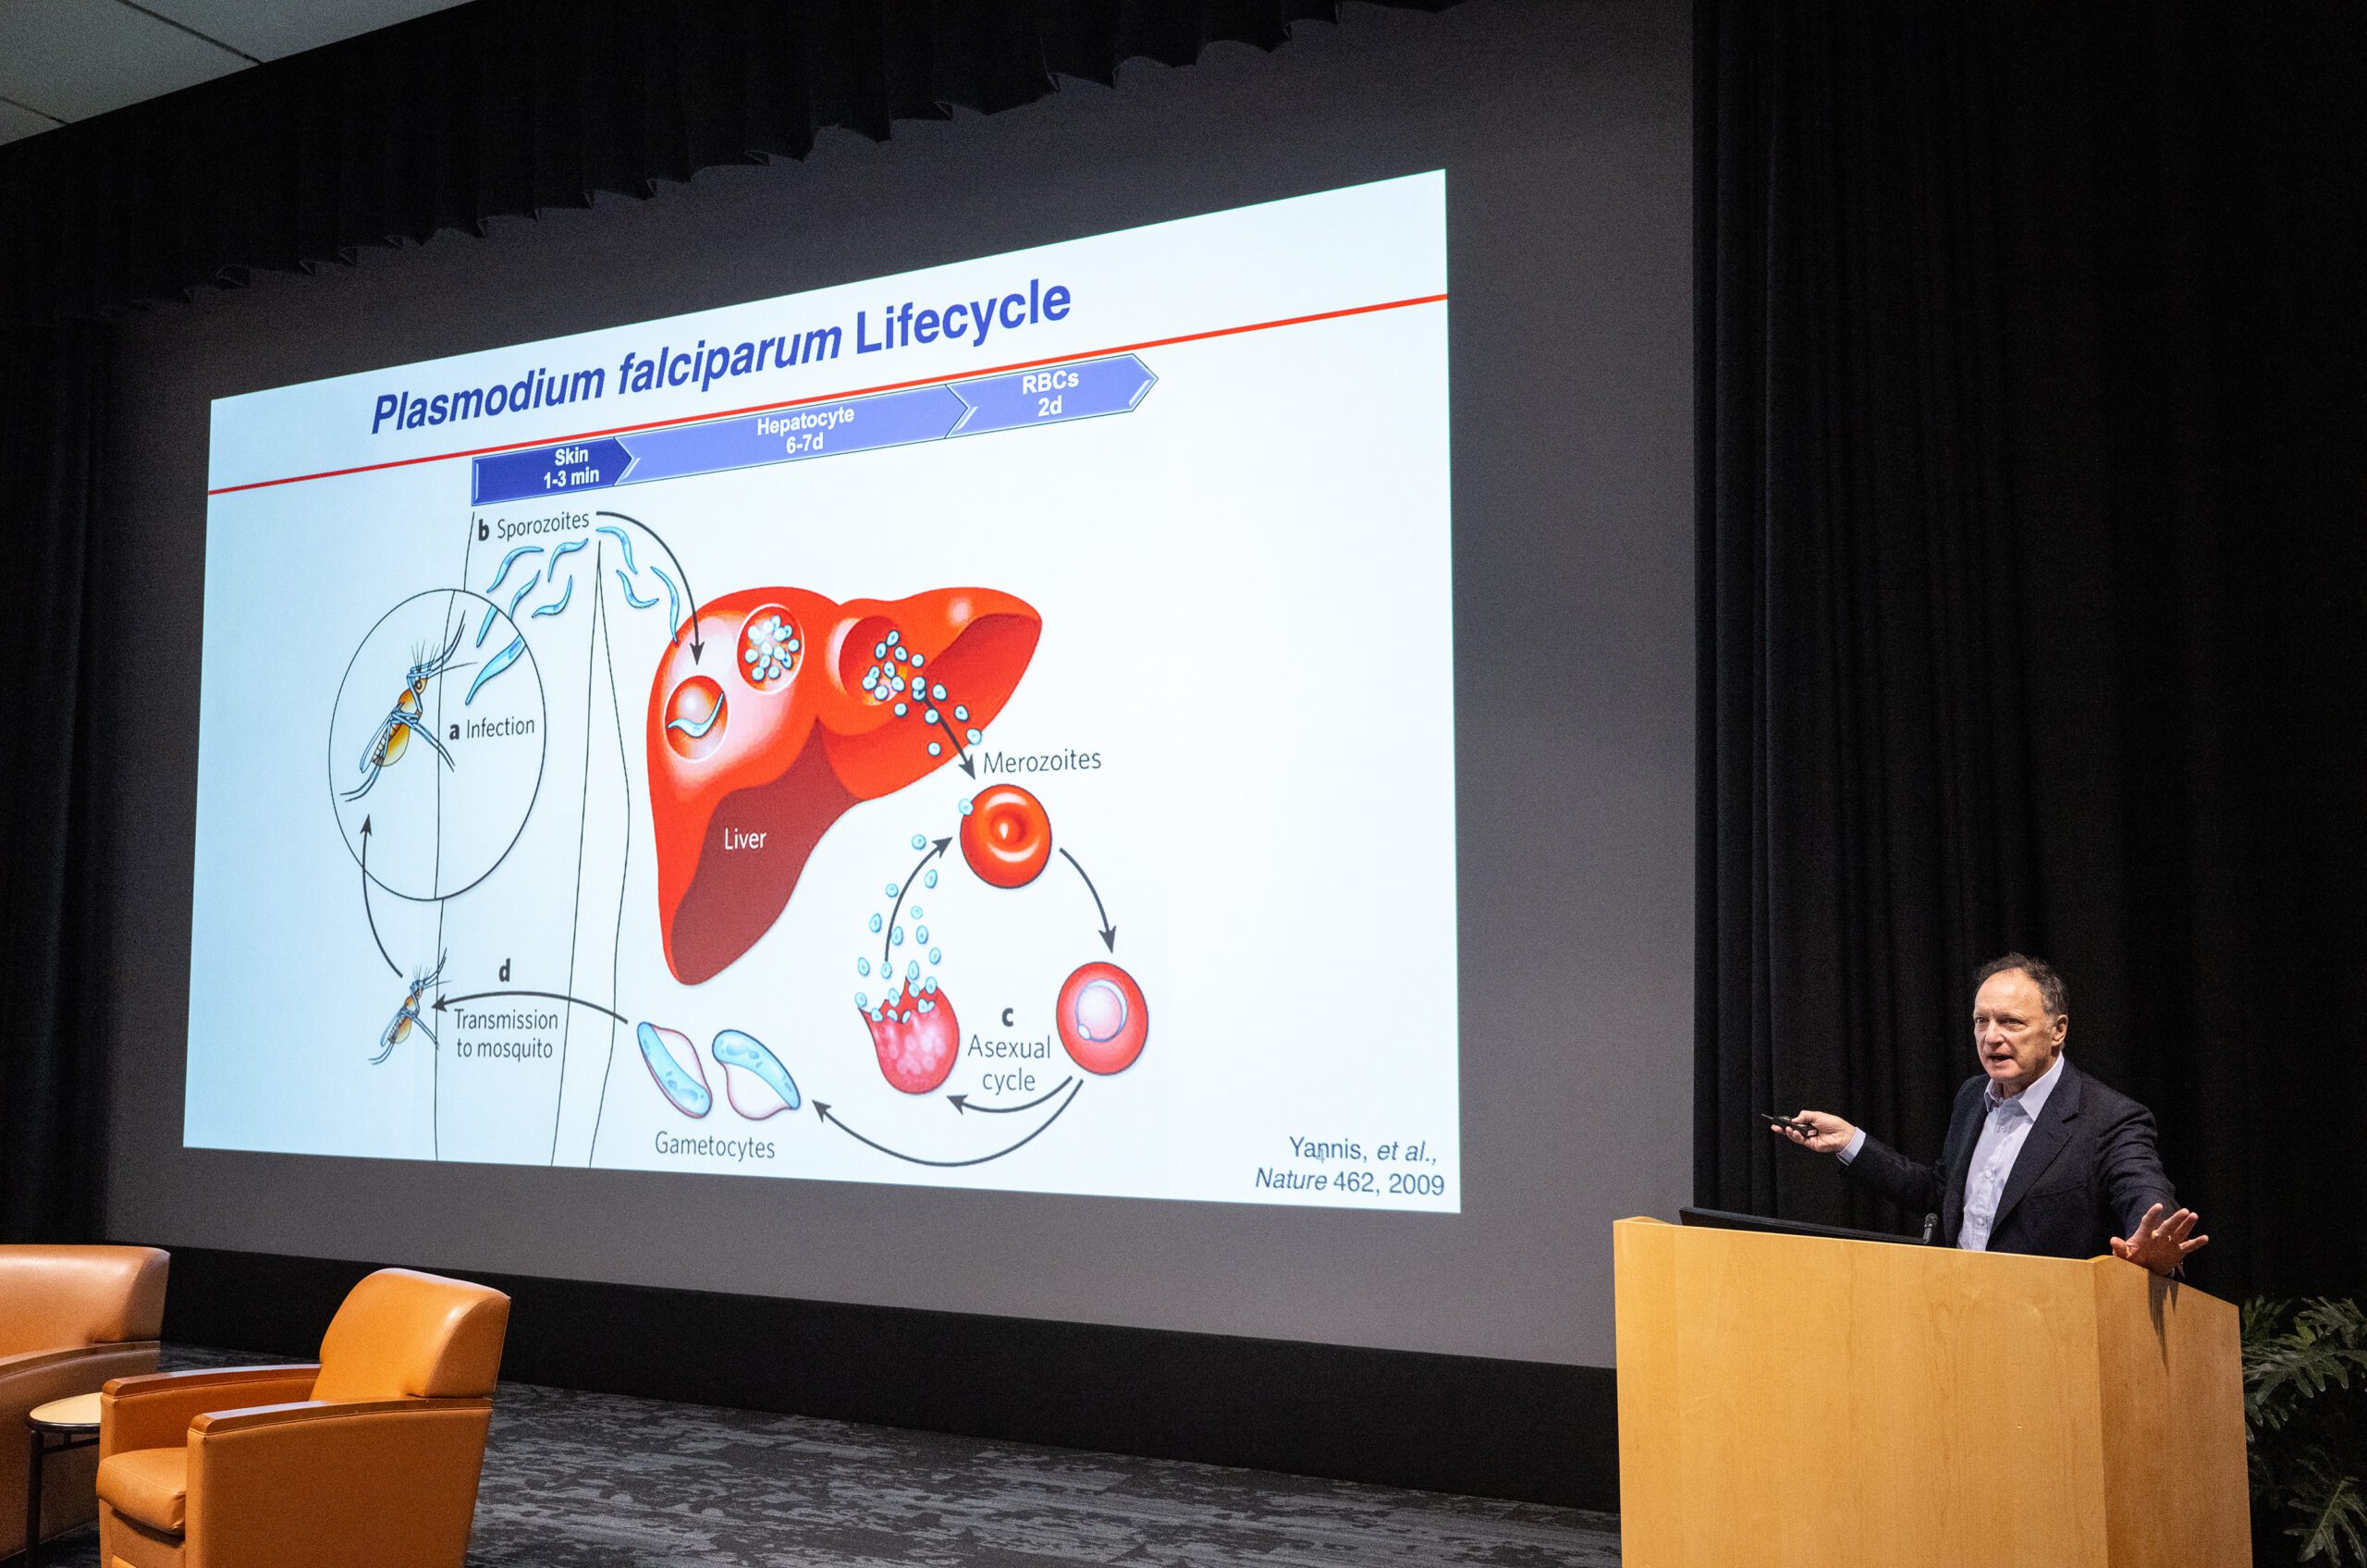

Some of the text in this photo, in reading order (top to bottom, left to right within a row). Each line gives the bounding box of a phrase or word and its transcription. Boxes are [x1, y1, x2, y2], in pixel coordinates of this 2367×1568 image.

[371, 278, 1072, 435] Plasmodium falciparum Lifecycle
[1022, 370, 1080, 395] RBCs
[1037, 395, 1062, 417] 2d
[757, 406, 855, 437] Hepatocyte
[786, 432, 824, 454] 6-7d
[555, 446, 589, 466] Skin
[543, 466, 600, 489] 1-3 min
[478, 510, 590, 542] b Sporozoites
[448, 717, 535, 741] a Infection
[983, 749, 1102, 775] Merozoites
[724, 828, 767, 851] Liver
[498, 958, 511, 983] d
[453, 1009, 558, 1030] Transmission
[1001, 1008, 1014, 1028] c
[457, 1038, 553, 1063] to mosquito
[967, 1035, 1050, 1060] Asexual
[982, 1068, 1036, 1096] cycle
[655, 1131, 776, 1163] Gametocytes
[1289, 1136, 1437, 1166] Yannis, et al.,
[1255, 1168, 1445, 1196] Nature 462, 2009
